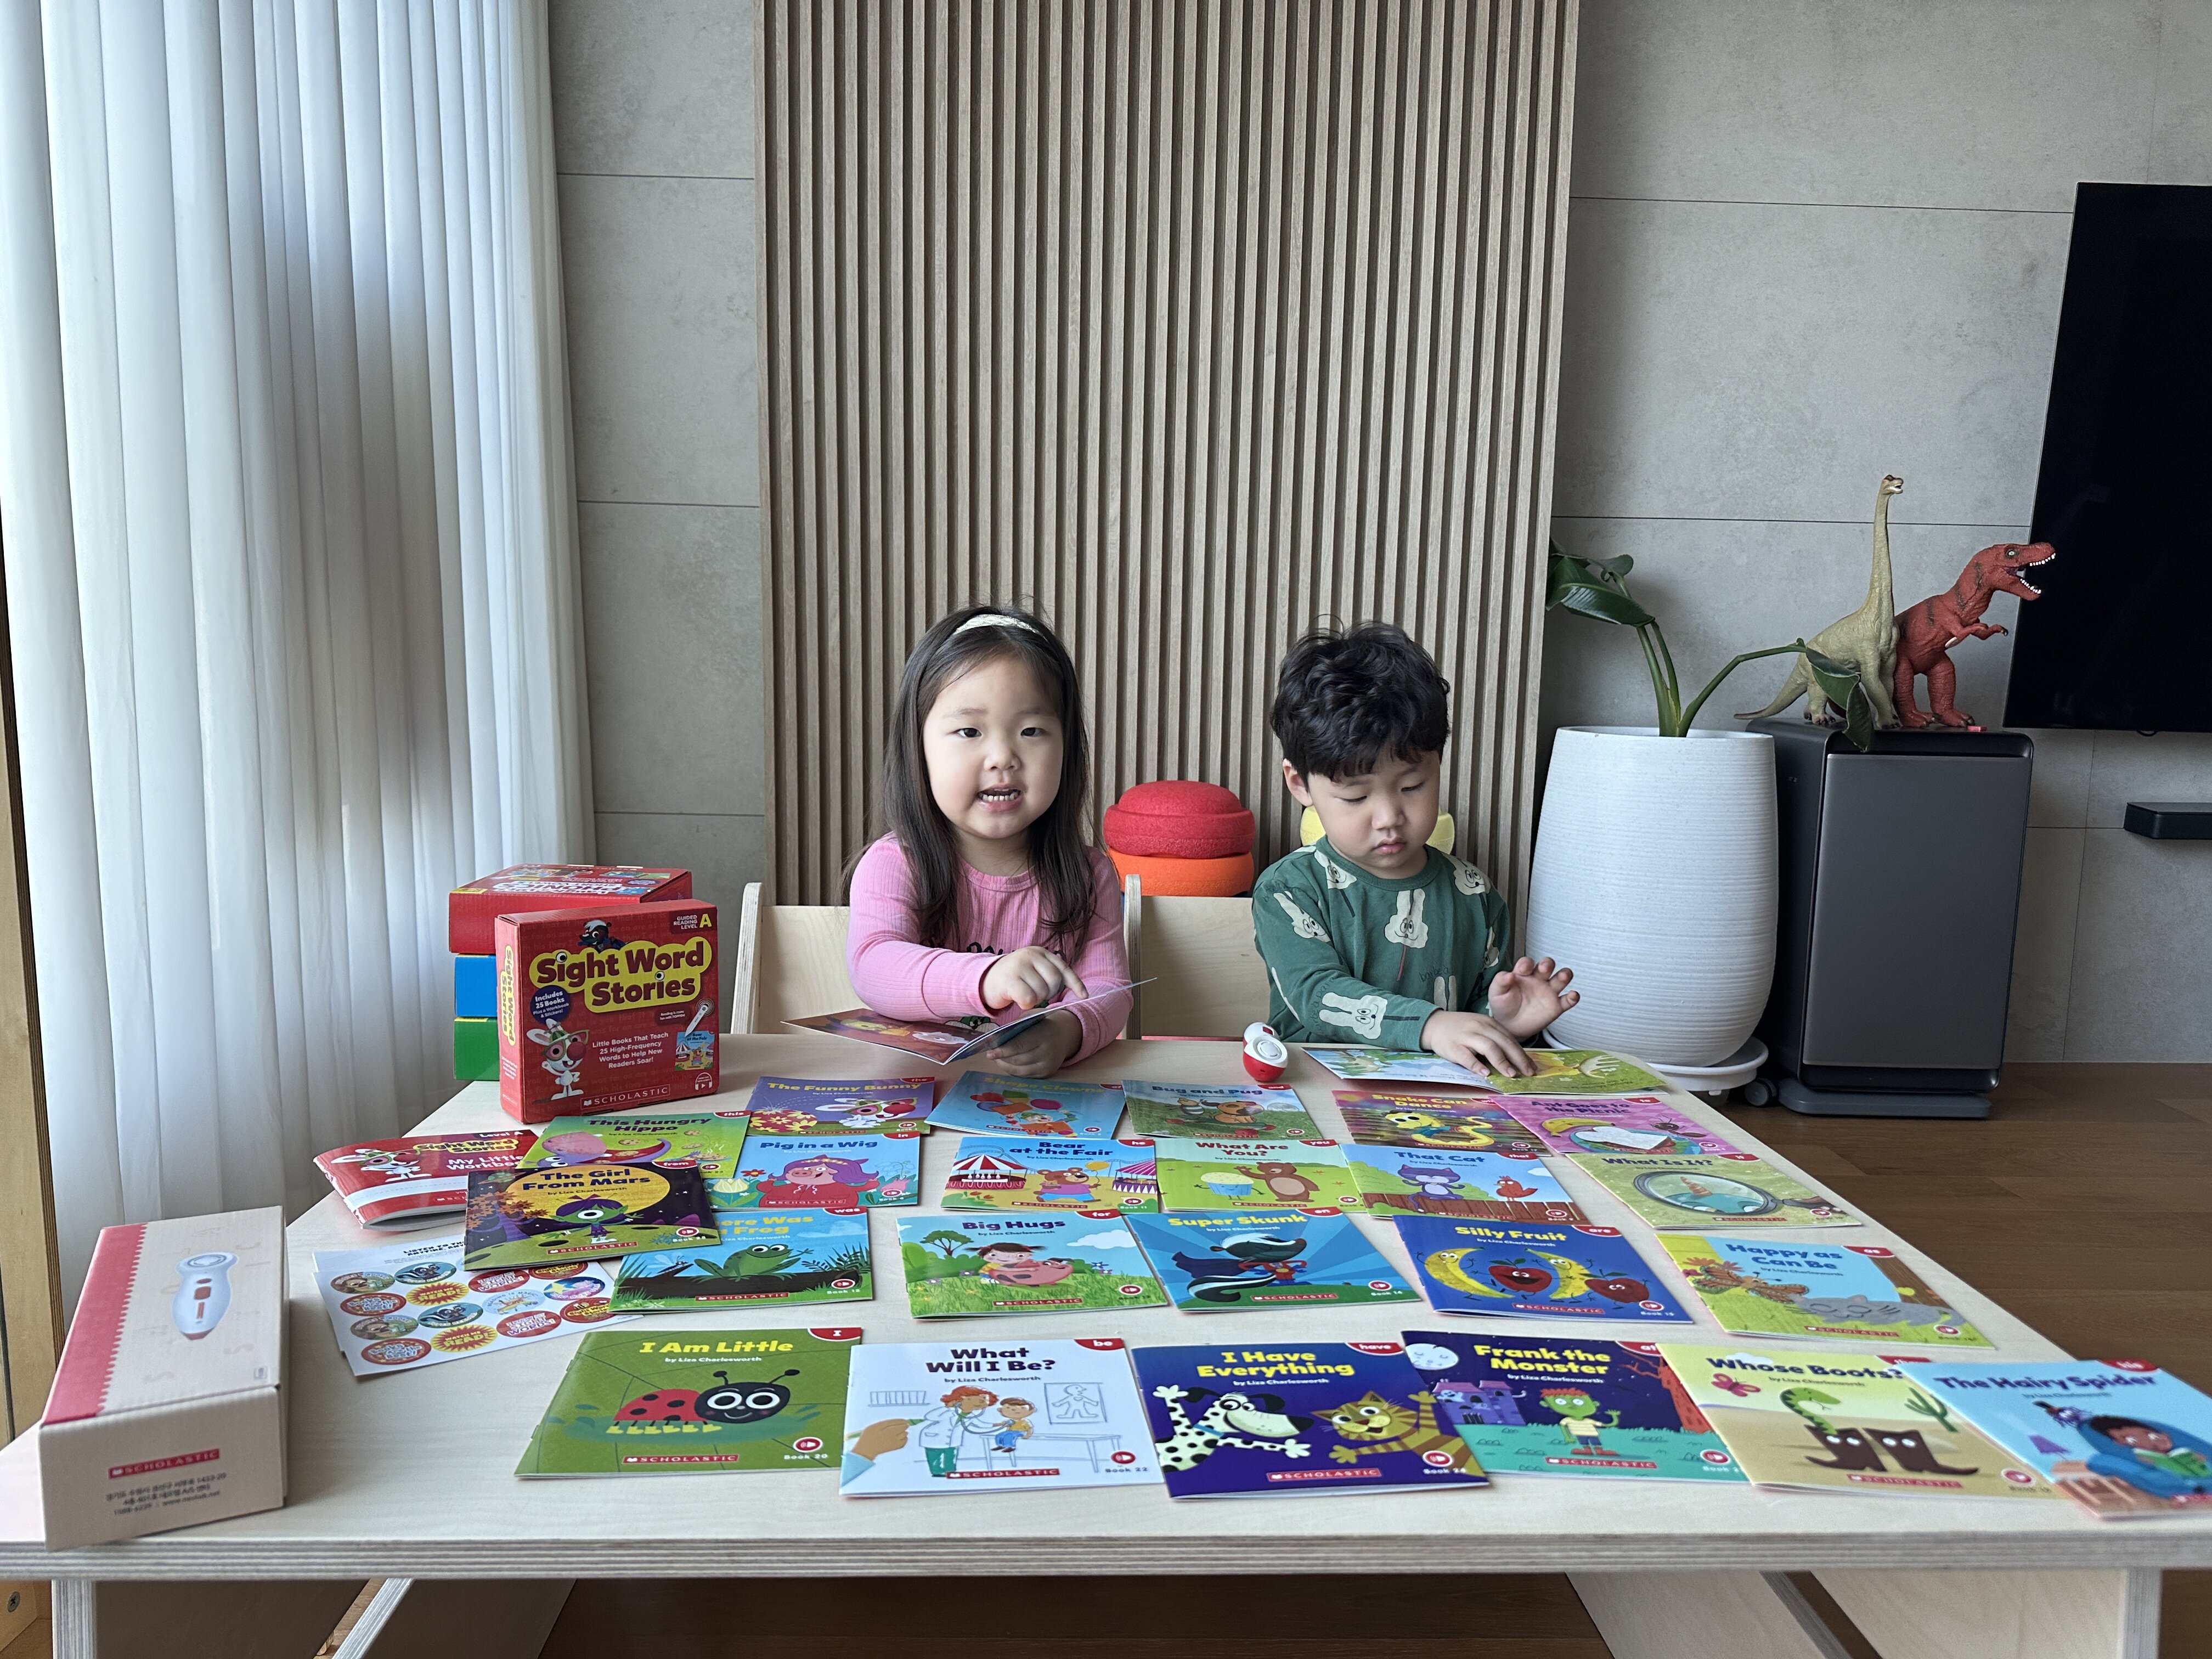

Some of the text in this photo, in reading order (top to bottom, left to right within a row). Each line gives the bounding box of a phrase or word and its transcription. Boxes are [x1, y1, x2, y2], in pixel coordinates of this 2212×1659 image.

[700, 914, 712, 928] A
[537, 941, 703, 987] Sight Word
[592, 970, 695, 1006] Stories
[535, 991, 563, 1002] Includes
[544, 997, 565, 1007] Books
[592, 1040, 610, 1048] Little
[610, 1041, 662, 1053] High-Frequency
[631, 1051, 646, 1059] Help
[594, 1087, 668, 1104] SCHOLASTIC
[1393, 1152, 1444, 1160] That
[589, 1169, 630, 1177] Girl
[523, 1176, 650, 1190] From Mars
[769, 1216, 814, 1226] Was
[962, 1218, 1065, 1231] Big Hugs
[1167, 1214, 1308, 1228] Super Skunk
[734, 1226, 789, 1235] Frog
[1454, 1226, 1567, 1242] Silly Fruit
[561, 1242, 636, 1252] SCHOLASTIC
[1725, 1244, 1843, 1260] Happy as
[1751, 1255, 1838, 1270] Can Be
[709, 1293, 787, 1301] SCHOLASTIC
[1526, 1304, 1604, 1313] SCHOLASTIC
[639, 1340, 793, 1353] I Am Little
[951, 1347, 1029, 1359] What
[1223, 1351, 1316, 1363] I Have
[1474, 1345, 1611, 1363] Frank the
[926, 1359, 1056, 1373] Will I Be?
[1197, 1363, 1355, 1378] Everything
[1491, 1357, 1608, 1375] Monster
[1706, 1357, 1904, 1380] Whose Boots?
[1934, 1375, 2157, 1391] The Hairy Spider
[125, 1452, 218, 1474] SCHOLASTIC
[1561, 1459, 1655, 1468] SCHOLASTIC
[962, 1469, 1058, 1478] SCHOLASTIC
[1284, 1469, 1378, 1479] SCHOLASTIC
